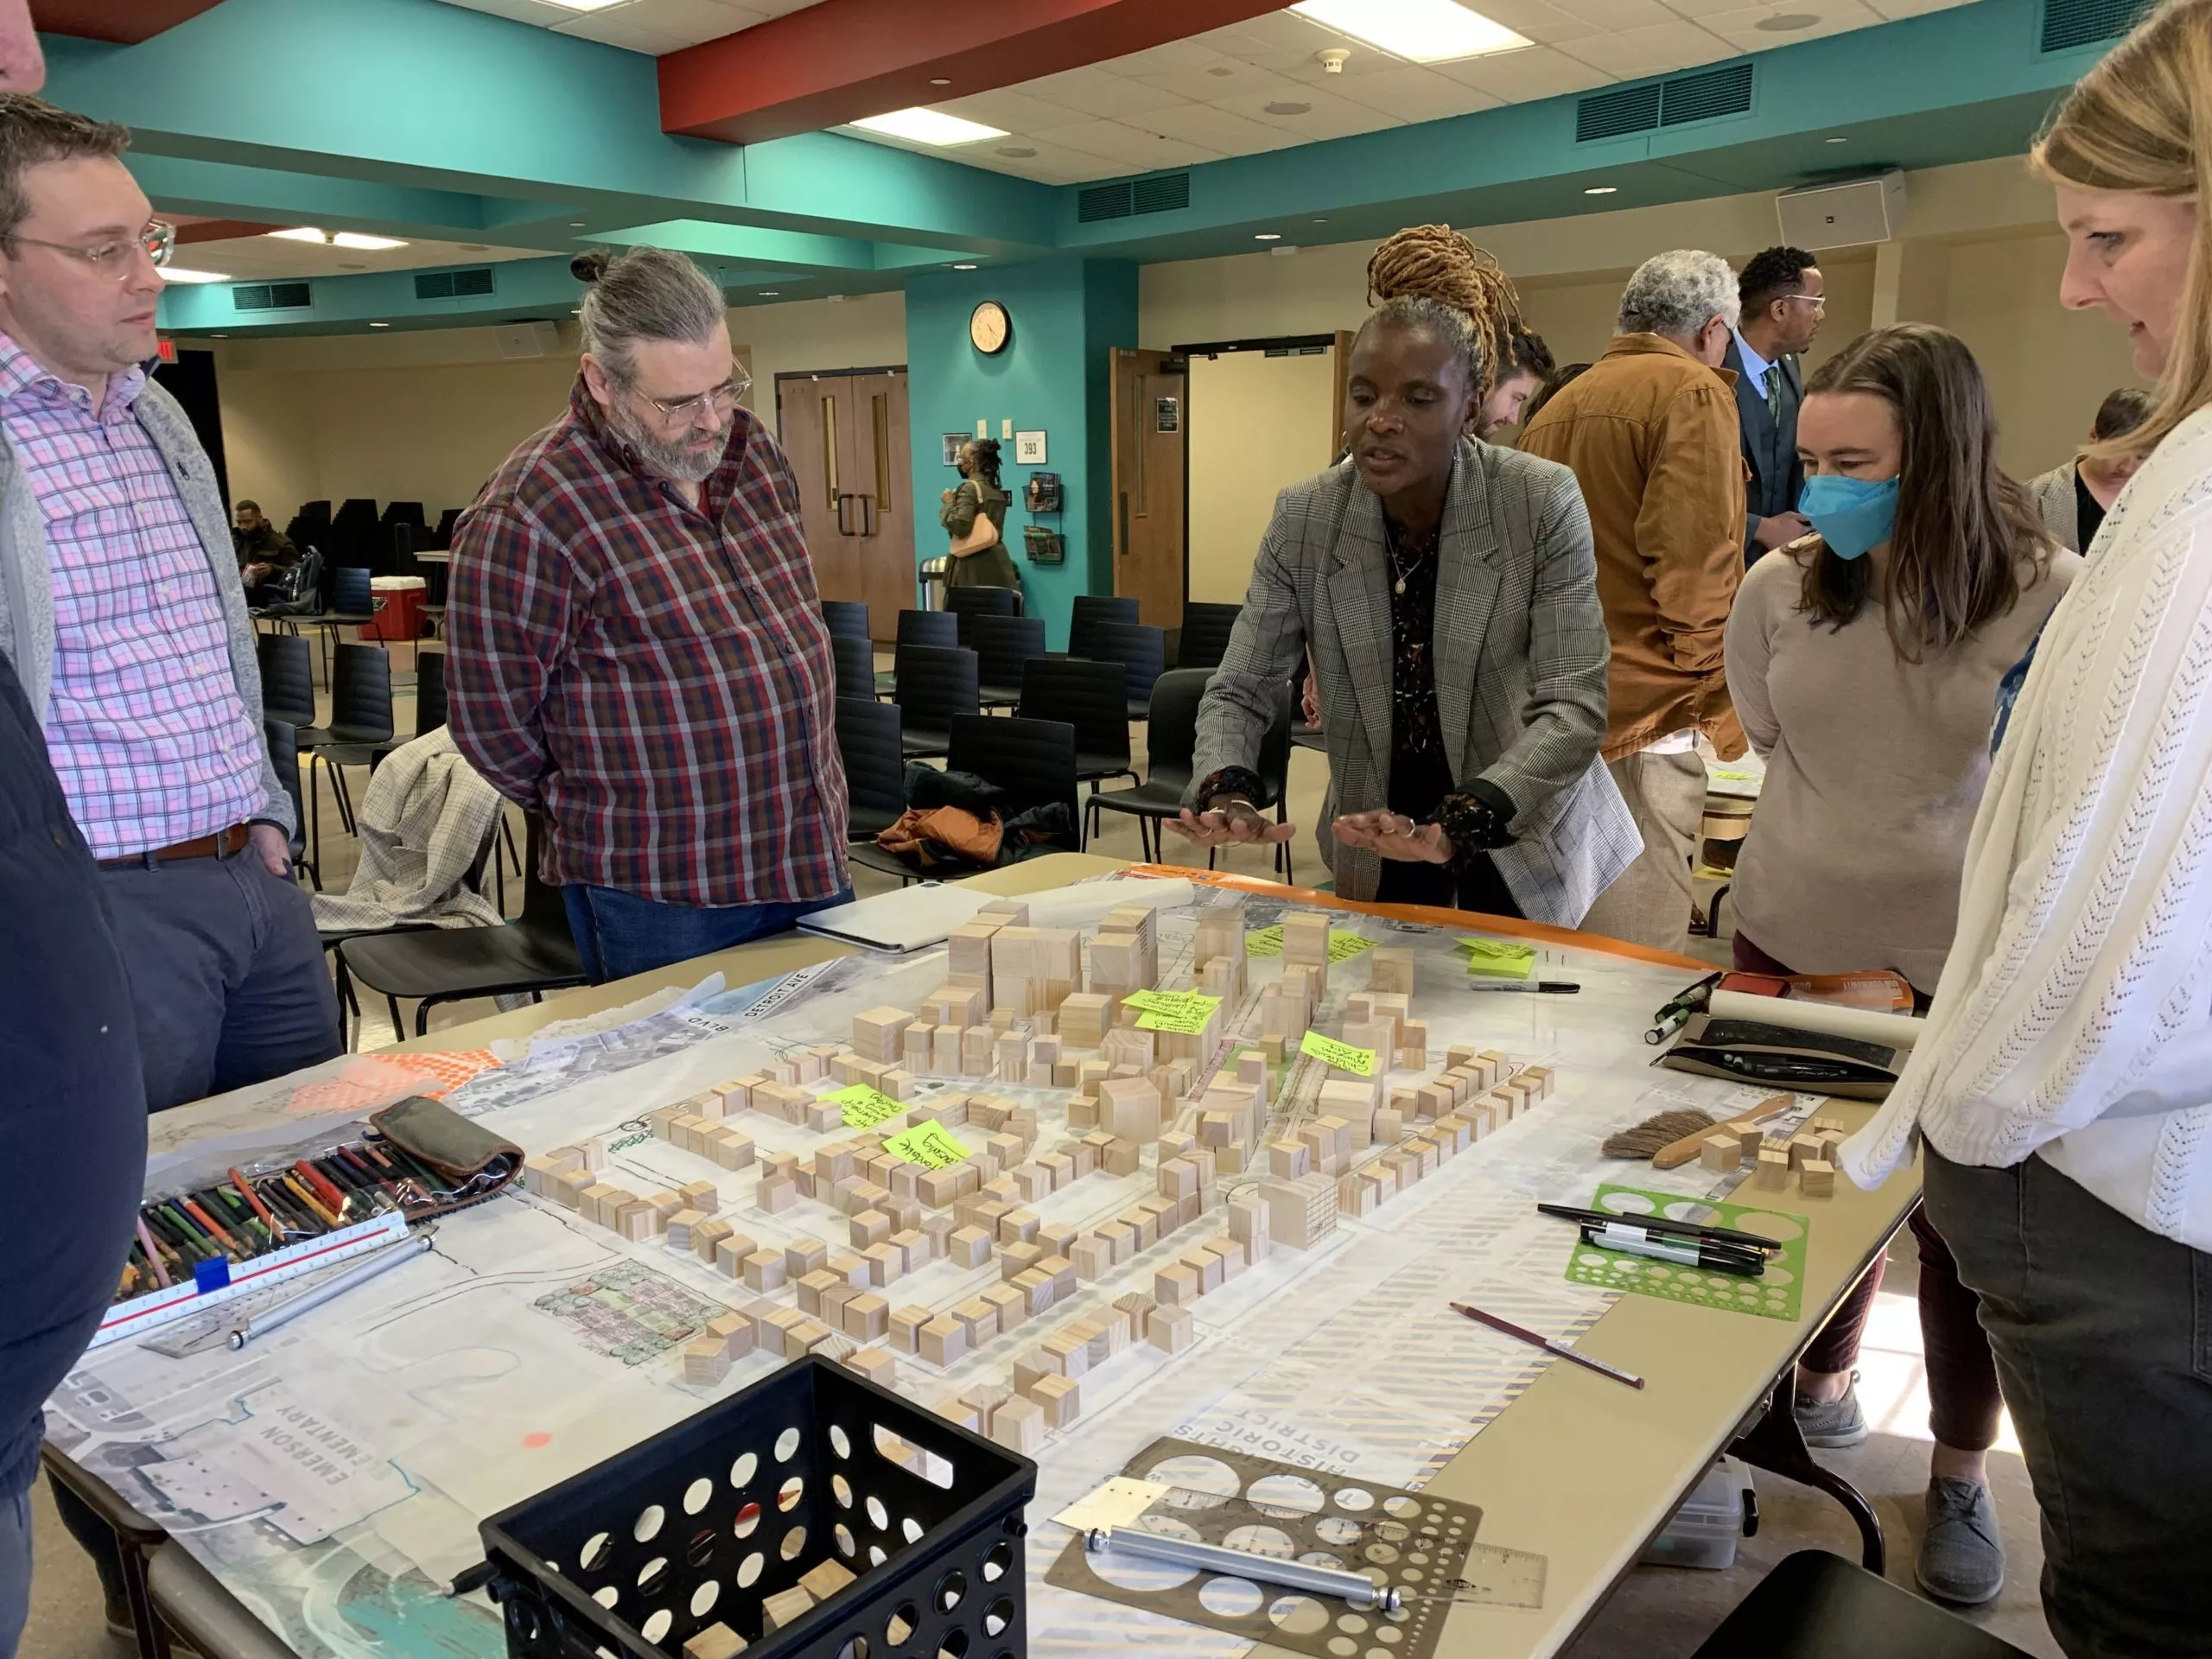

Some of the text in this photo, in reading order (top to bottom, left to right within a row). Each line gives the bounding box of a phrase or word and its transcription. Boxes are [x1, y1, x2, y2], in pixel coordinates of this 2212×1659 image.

[1024, 442, 1037, 455] 393
[744, 973, 810, 1018] DETROIT AVE
[688, 1017, 730, 1032] BLVD
[922, 1133, 959, 1165] ousing
[260, 1426, 349, 1485] EMERSON
[1215, 1421, 1348, 1478] HISTORIC
[1234, 1408, 1360, 1464] DISTRICT
